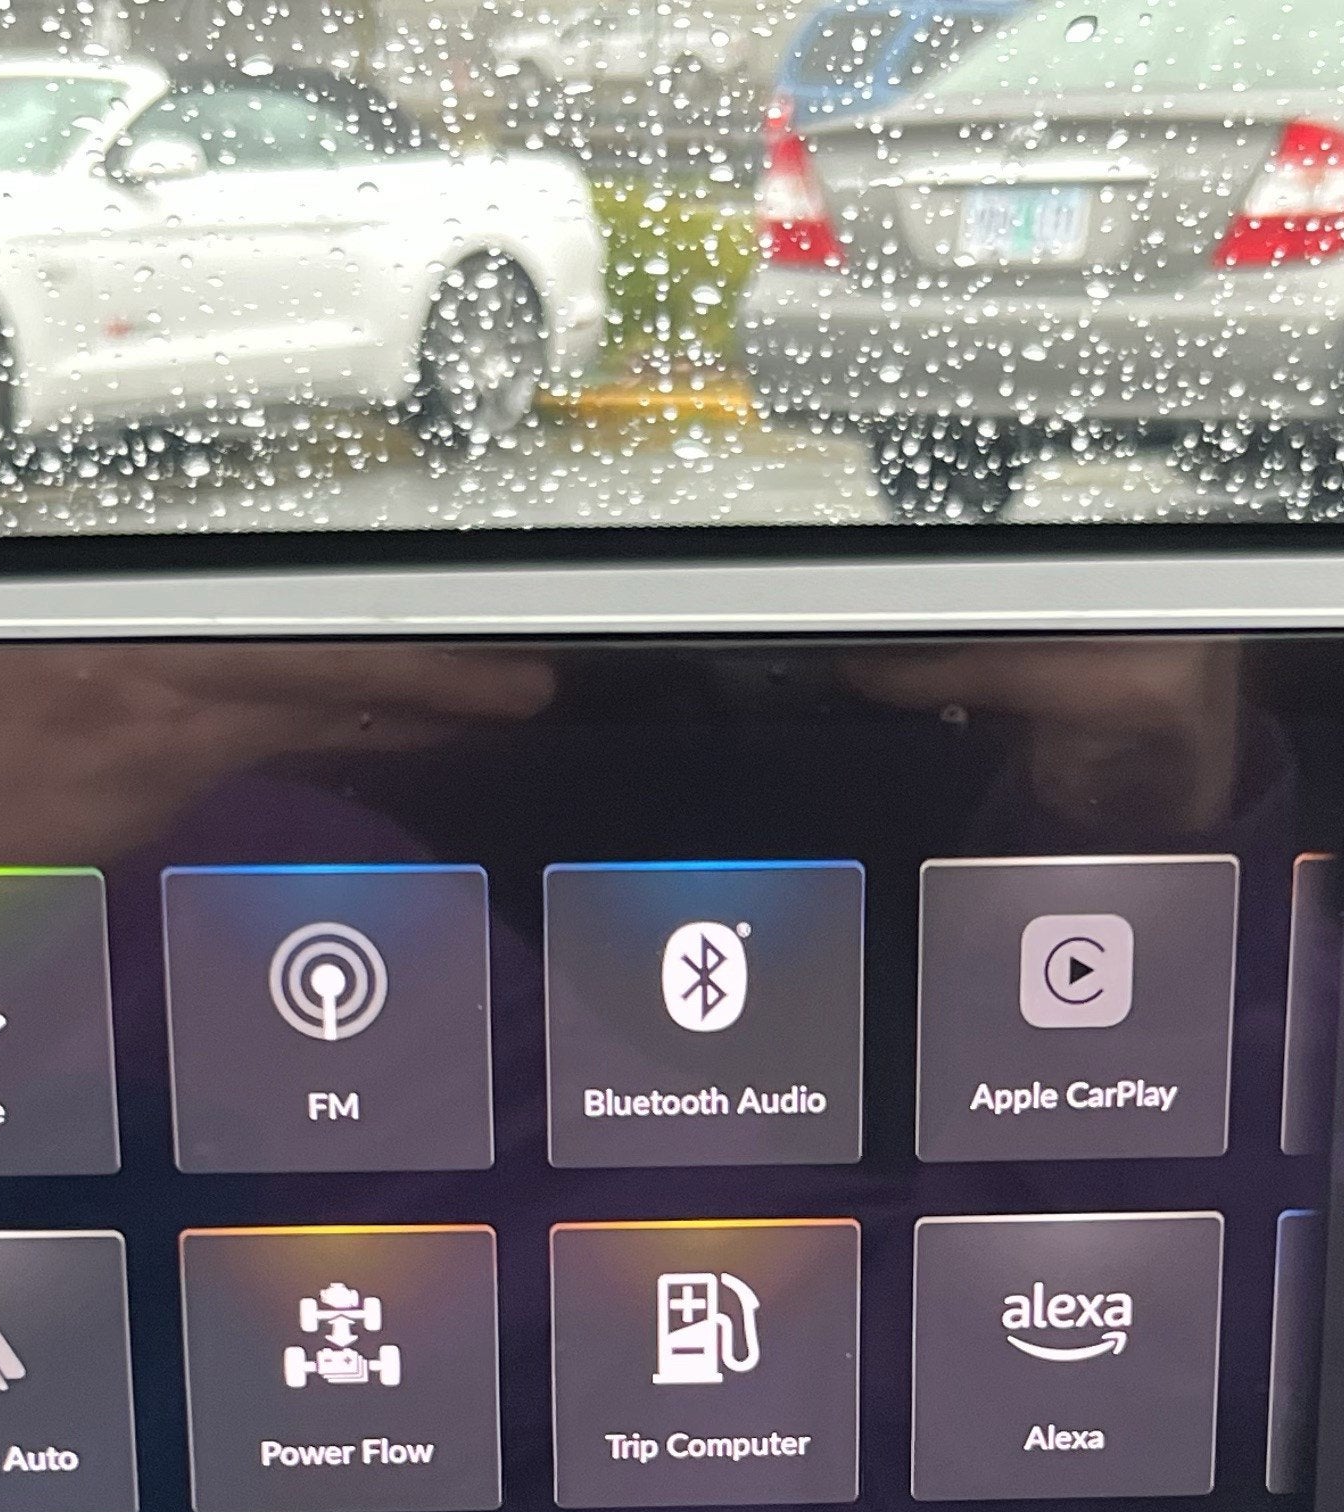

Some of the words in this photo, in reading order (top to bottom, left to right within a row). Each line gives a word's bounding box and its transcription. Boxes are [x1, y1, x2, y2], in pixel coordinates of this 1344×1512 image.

[308, 1092, 359, 1121] FM
[584, 1086, 729, 1117] Bluetooth
[736, 1084, 827, 1115] Audio
[969, 1081, 1059, 1115] Apple
[1066, 1079, 1178, 1112] CarPlay
[1001, 1281, 1133, 1330] alexa
[260, 1440, 356, 1467] Power
[361, 1437, 435, 1465] Flow
[604, 1432, 659, 1464] Trip
[666, 1432, 812, 1462] Computer
[1023, 1424, 1105, 1451] Alexa
[2, 1445, 80, 1472] Auto
